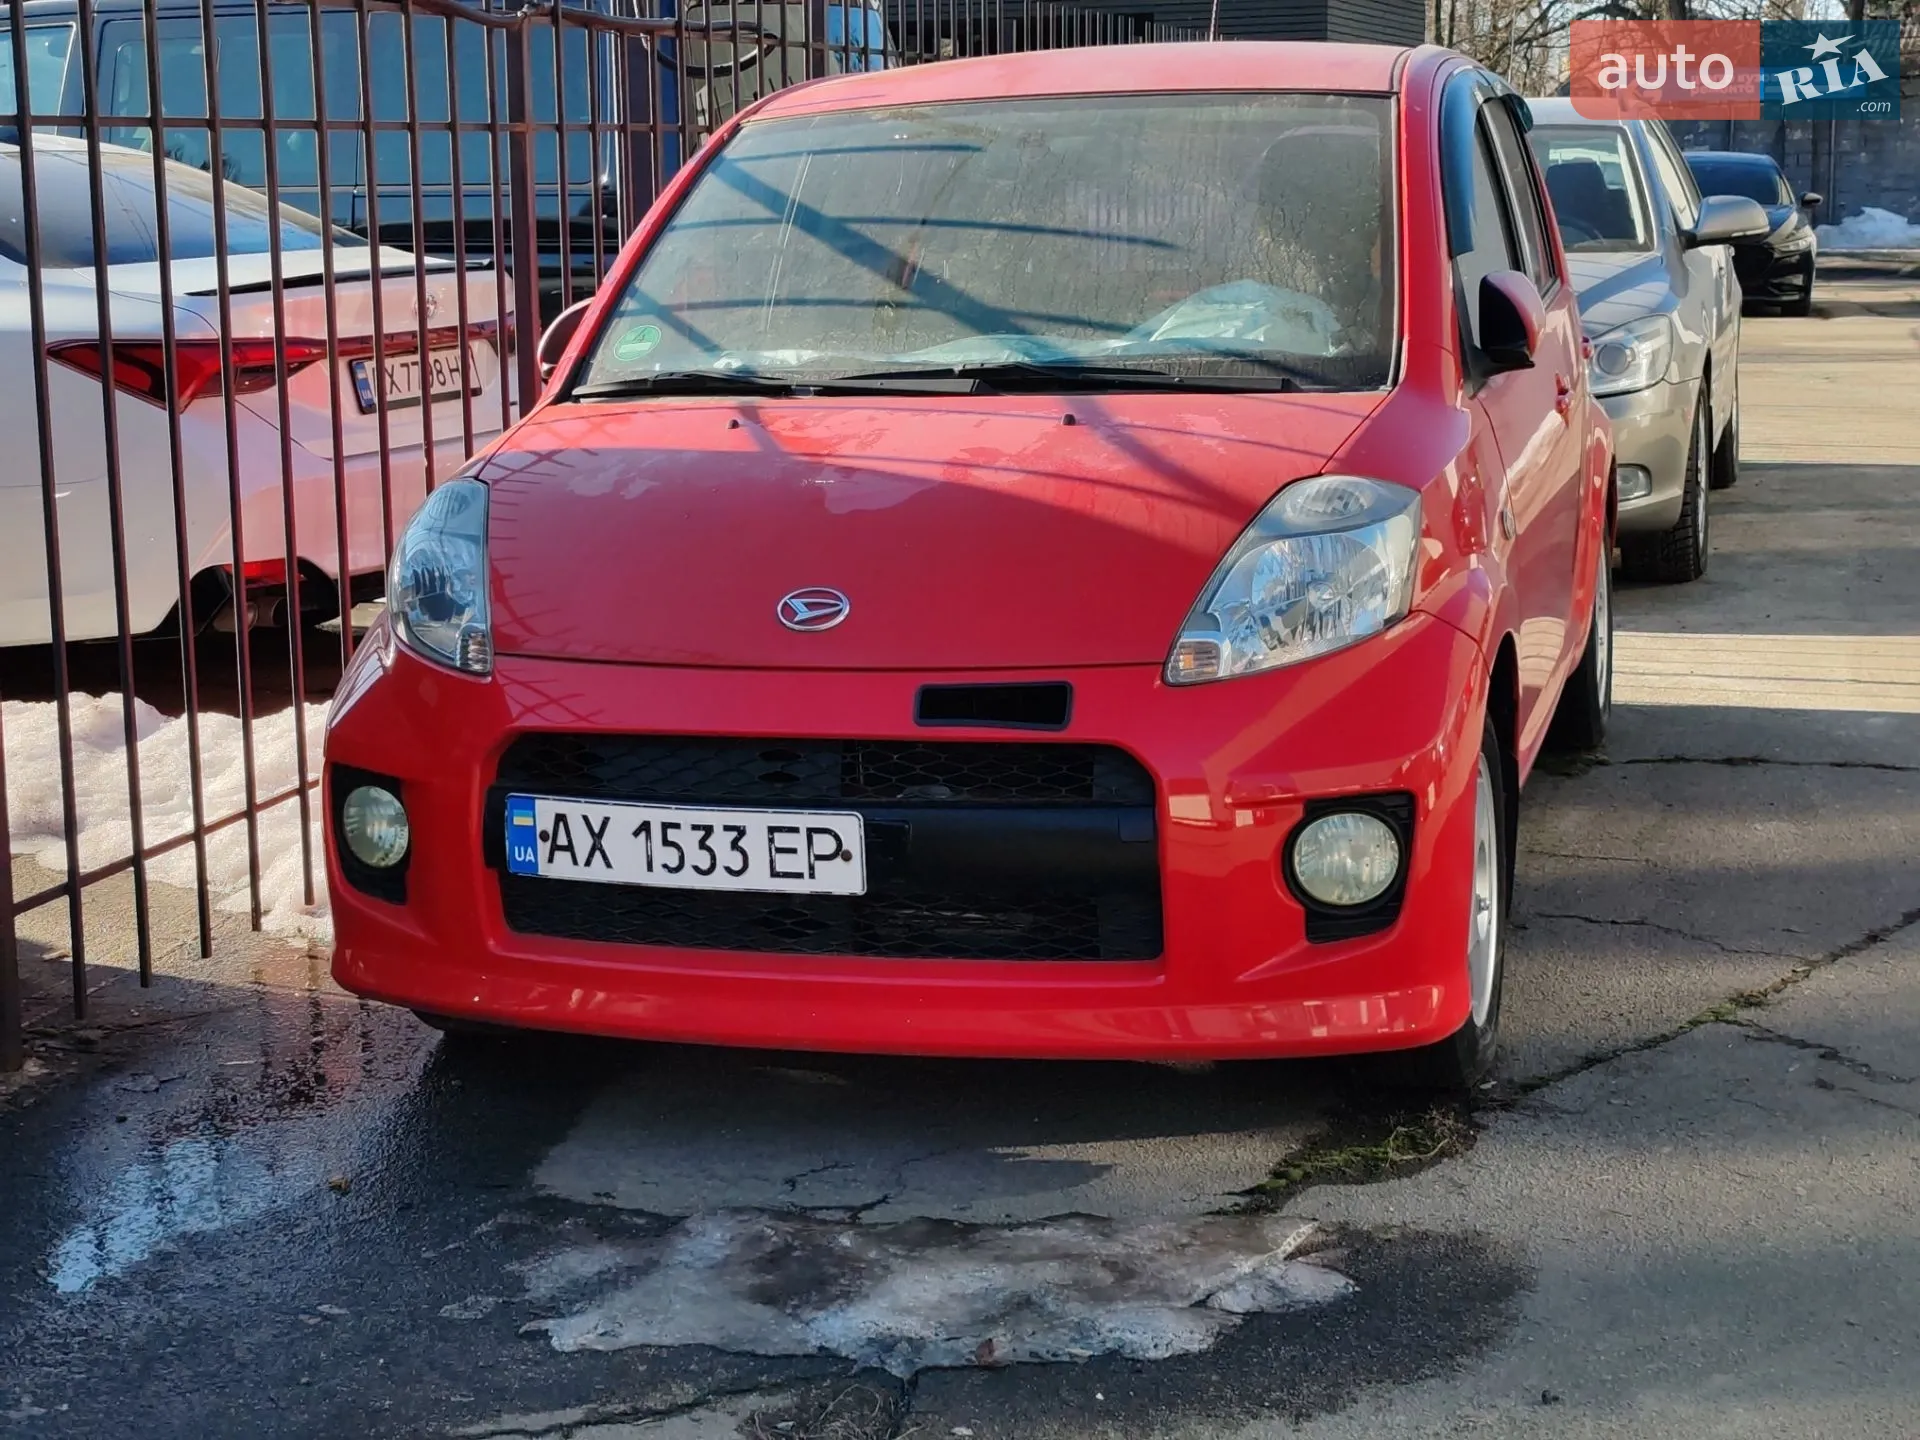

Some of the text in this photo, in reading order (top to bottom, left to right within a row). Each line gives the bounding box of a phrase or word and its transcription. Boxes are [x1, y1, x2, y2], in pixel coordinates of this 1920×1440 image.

[514, 845, 536, 863] UA
[547, 812, 844, 880] AX 1533 EP
